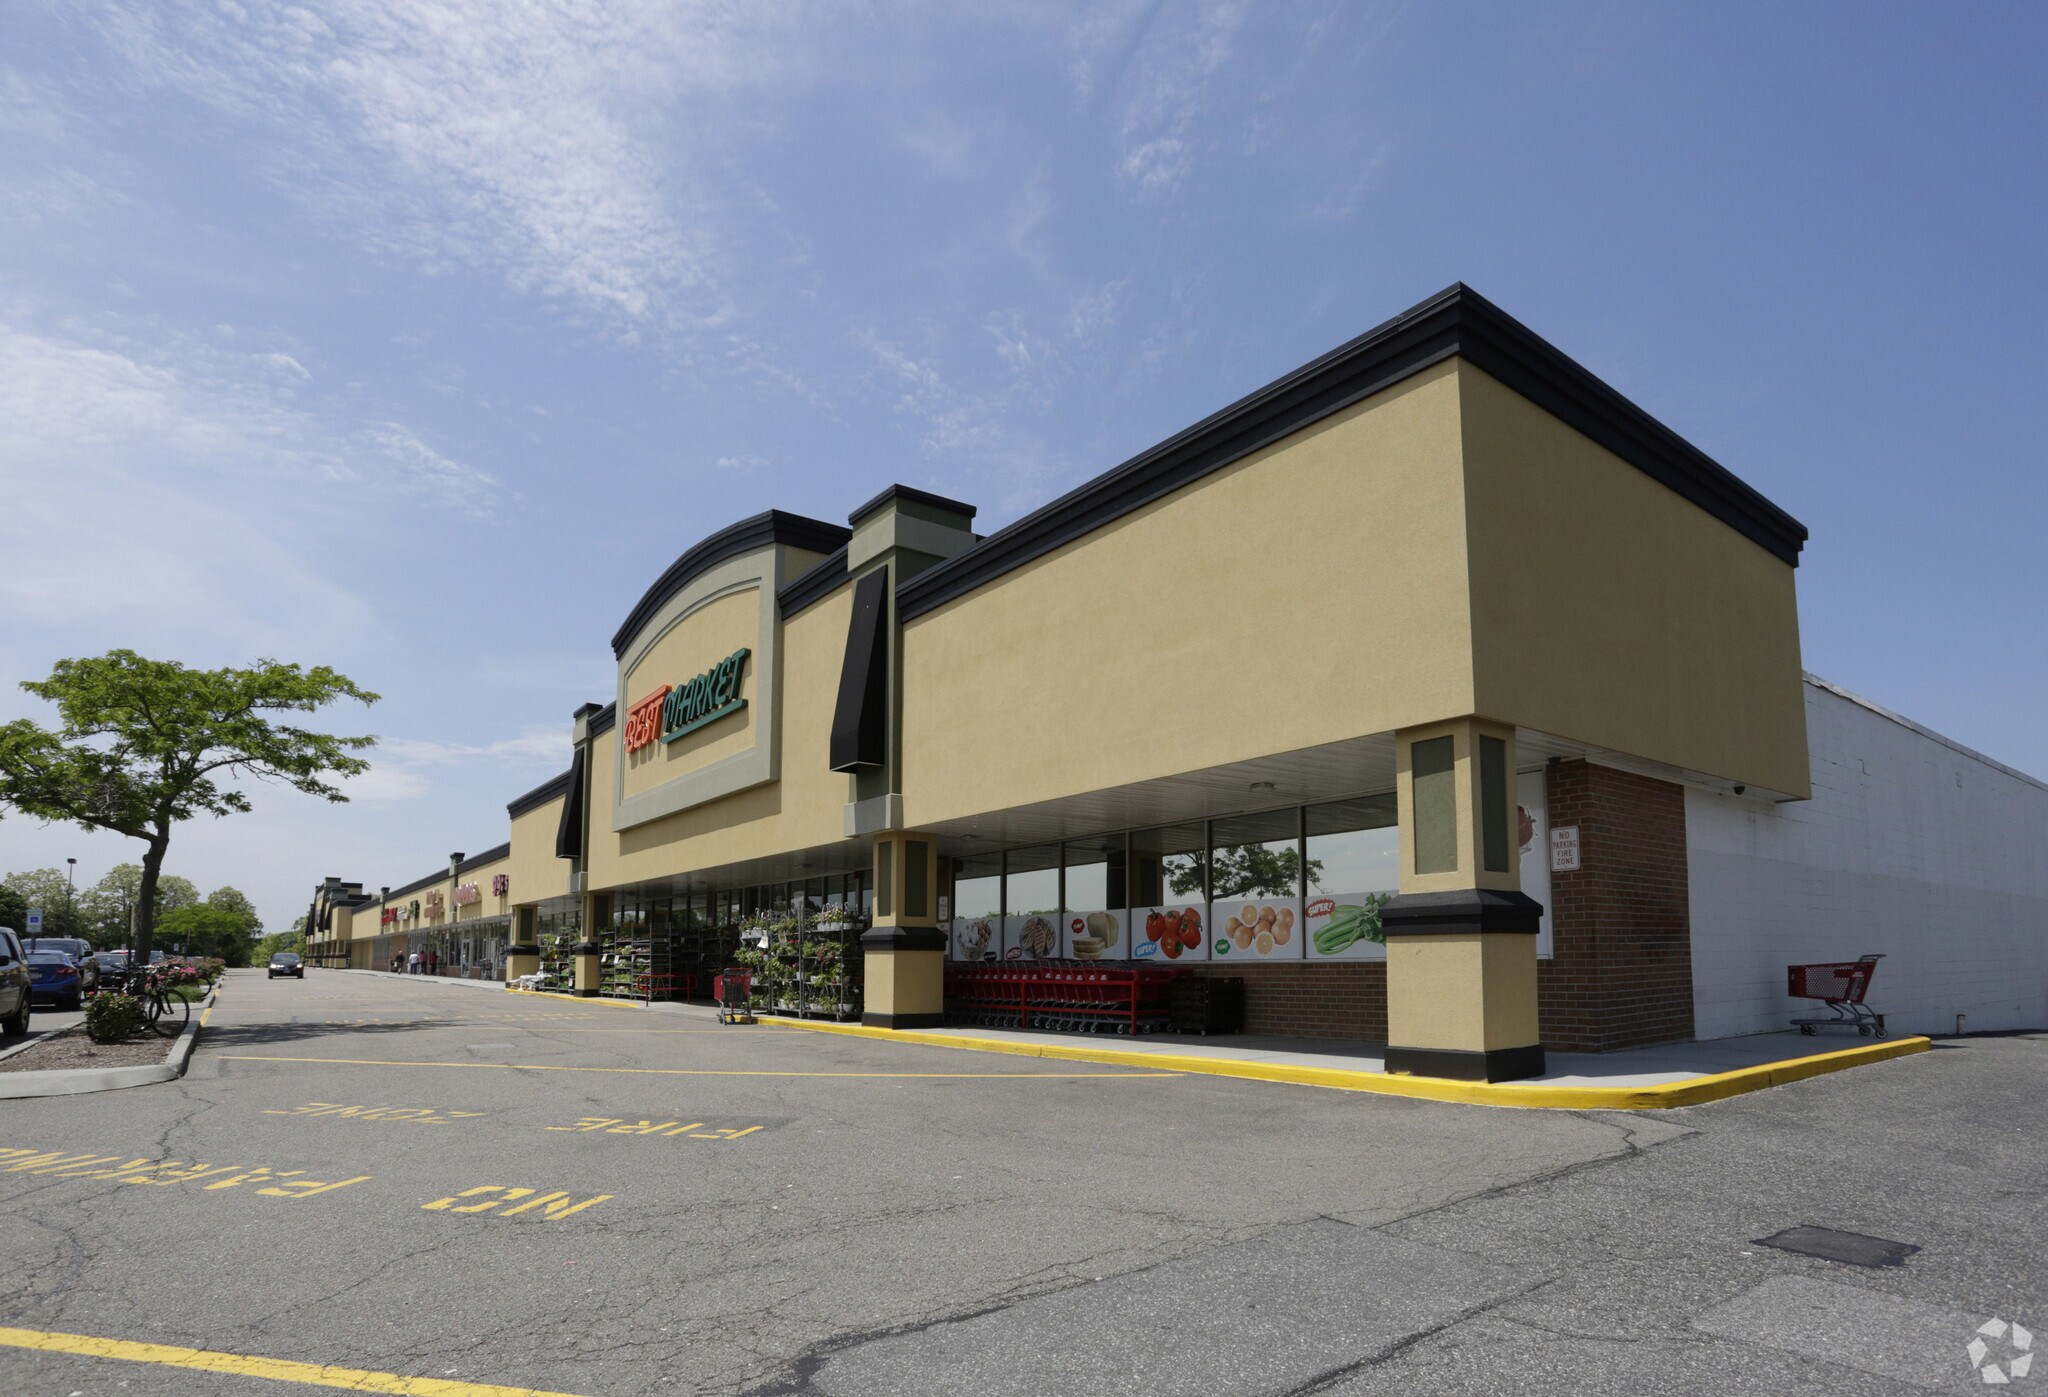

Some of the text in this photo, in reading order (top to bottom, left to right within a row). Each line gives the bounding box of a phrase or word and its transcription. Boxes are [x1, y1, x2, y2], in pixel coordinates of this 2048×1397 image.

[625, 648, 751, 753] BEST MARKET
[1559, 831, 1570, 839] NO
[1552, 840, 1577, 850] PARKING
[1557, 849, 1573, 857] FIRE
[1556, 857, 1575, 866] ZONE
[1308, 902, 1333, 916] SUPER!
[263, 1103, 763, 1140] FIRE ZONE
[421, 1186, 614, 1221] NO
